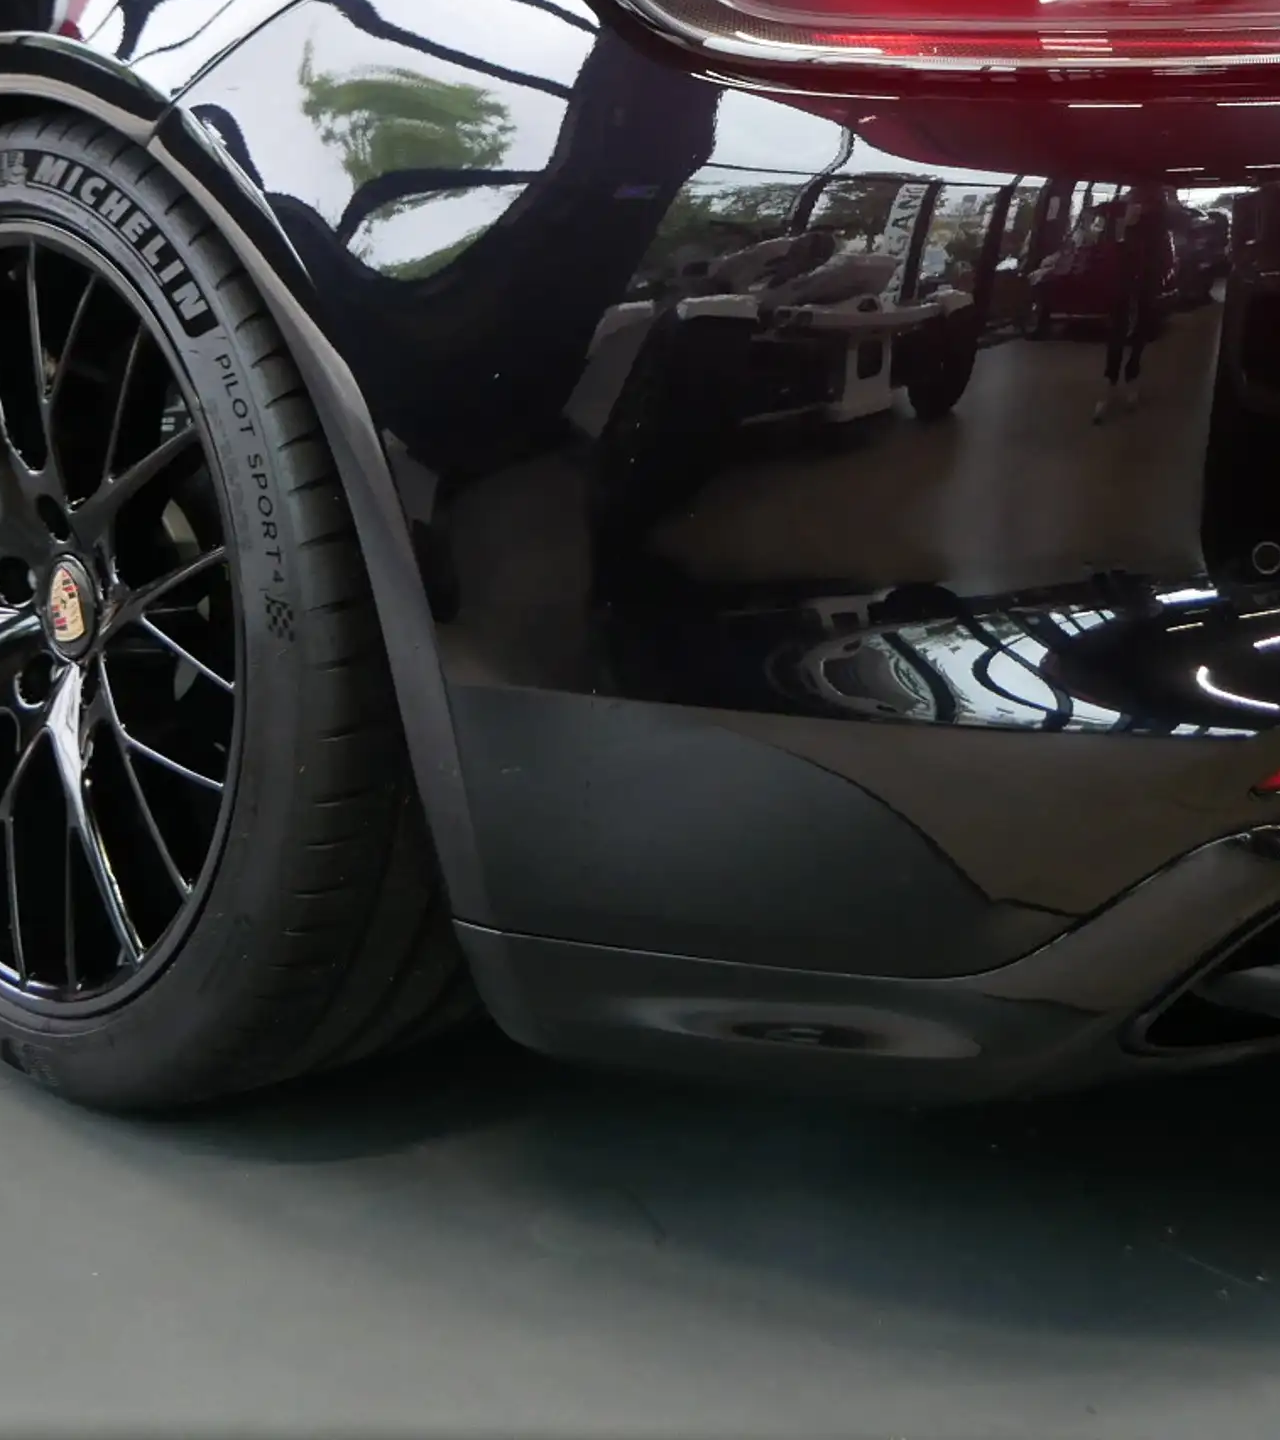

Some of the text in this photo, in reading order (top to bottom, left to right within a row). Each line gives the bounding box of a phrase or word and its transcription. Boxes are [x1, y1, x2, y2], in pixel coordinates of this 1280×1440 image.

[34, 156, 209, 324] MICHELIN
[215, 353, 257, 437] PILOT
[247, 453, 284, 557] SPORT
